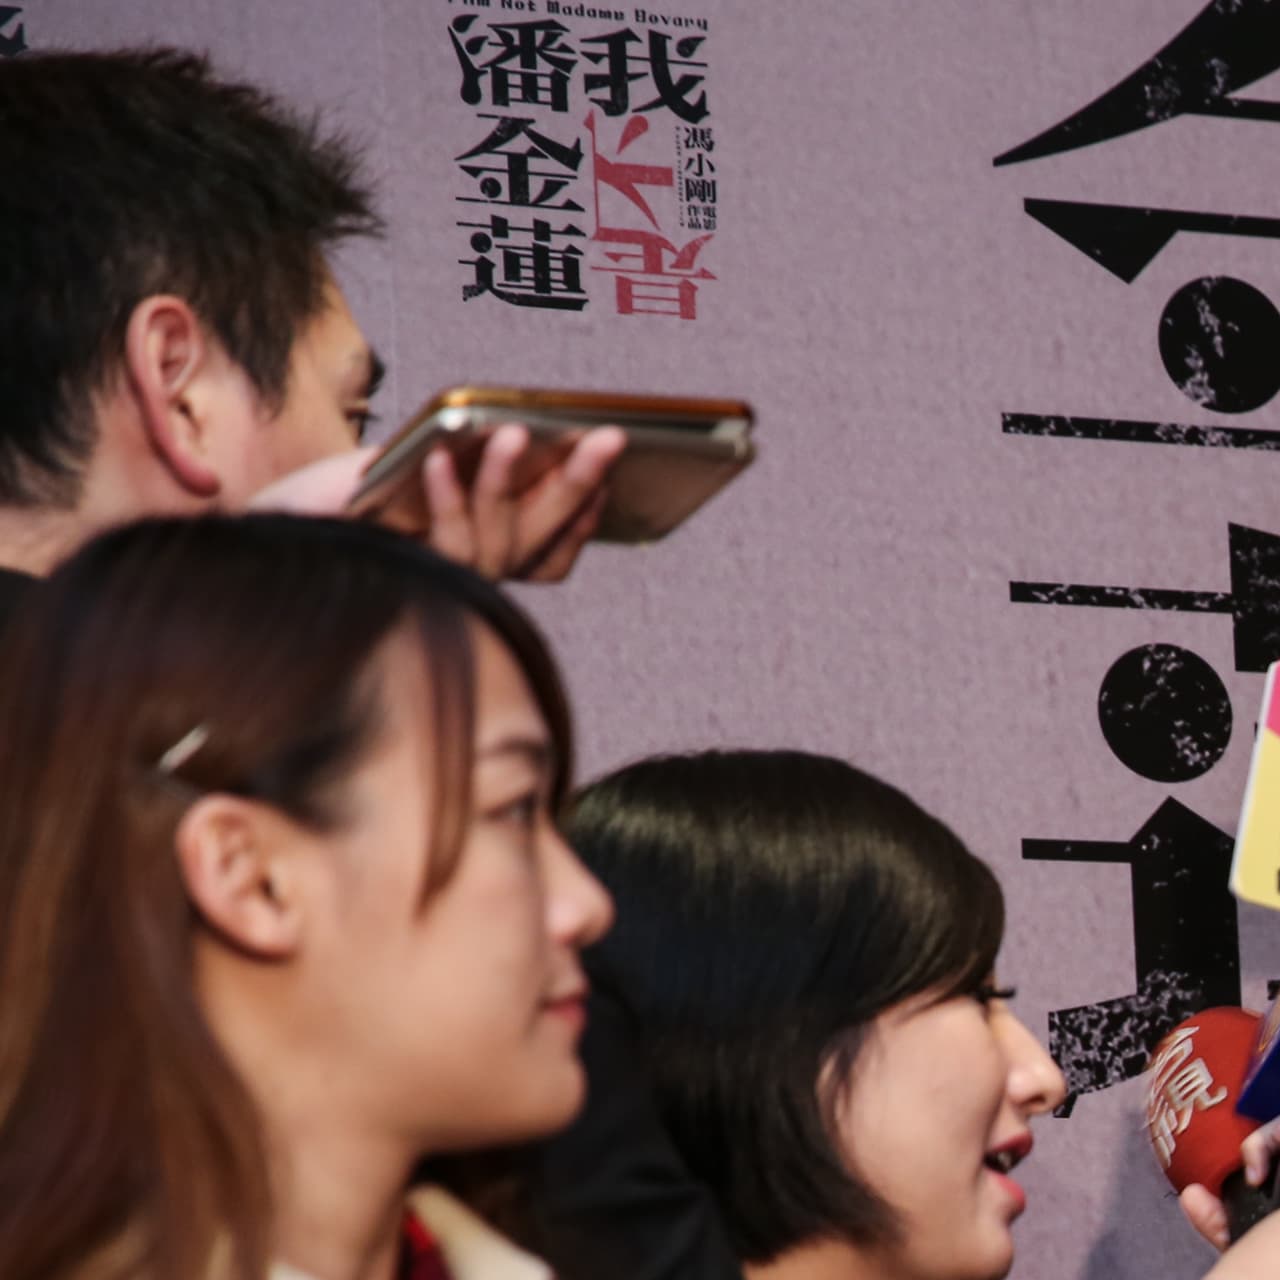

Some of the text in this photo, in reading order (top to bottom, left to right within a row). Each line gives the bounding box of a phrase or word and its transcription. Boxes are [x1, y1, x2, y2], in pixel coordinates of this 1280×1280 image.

[635, 9, 710, 31] Bovary
[448, 14, 588, 313] 潘金蓮
